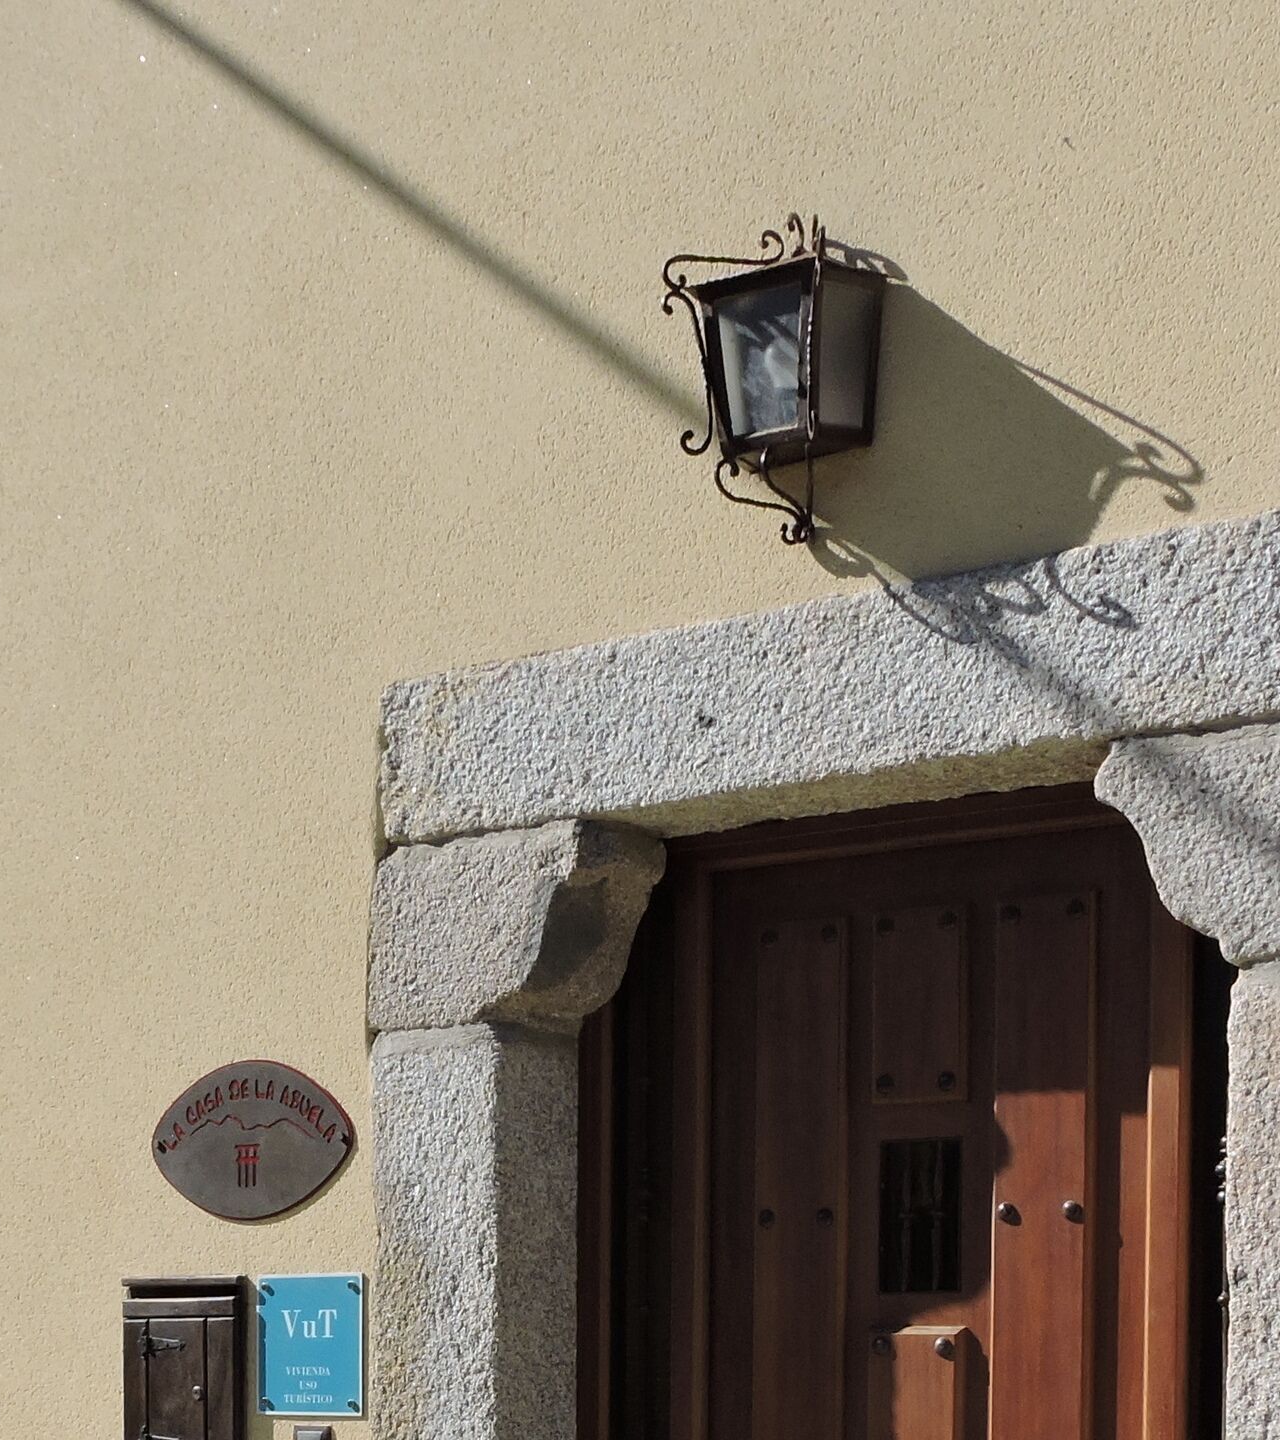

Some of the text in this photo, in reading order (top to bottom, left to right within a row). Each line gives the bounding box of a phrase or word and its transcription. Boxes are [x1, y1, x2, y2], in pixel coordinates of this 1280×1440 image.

[164, 1079, 337, 1150] LA CASA DE LA ABUELA
[281, 1309, 338, 1339] VuT
[285, 1366, 331, 1377] VIVIENDA
[299, 1380, 318, 1390] USO
[283, 1392, 333, 1404] TURÍSTICO
